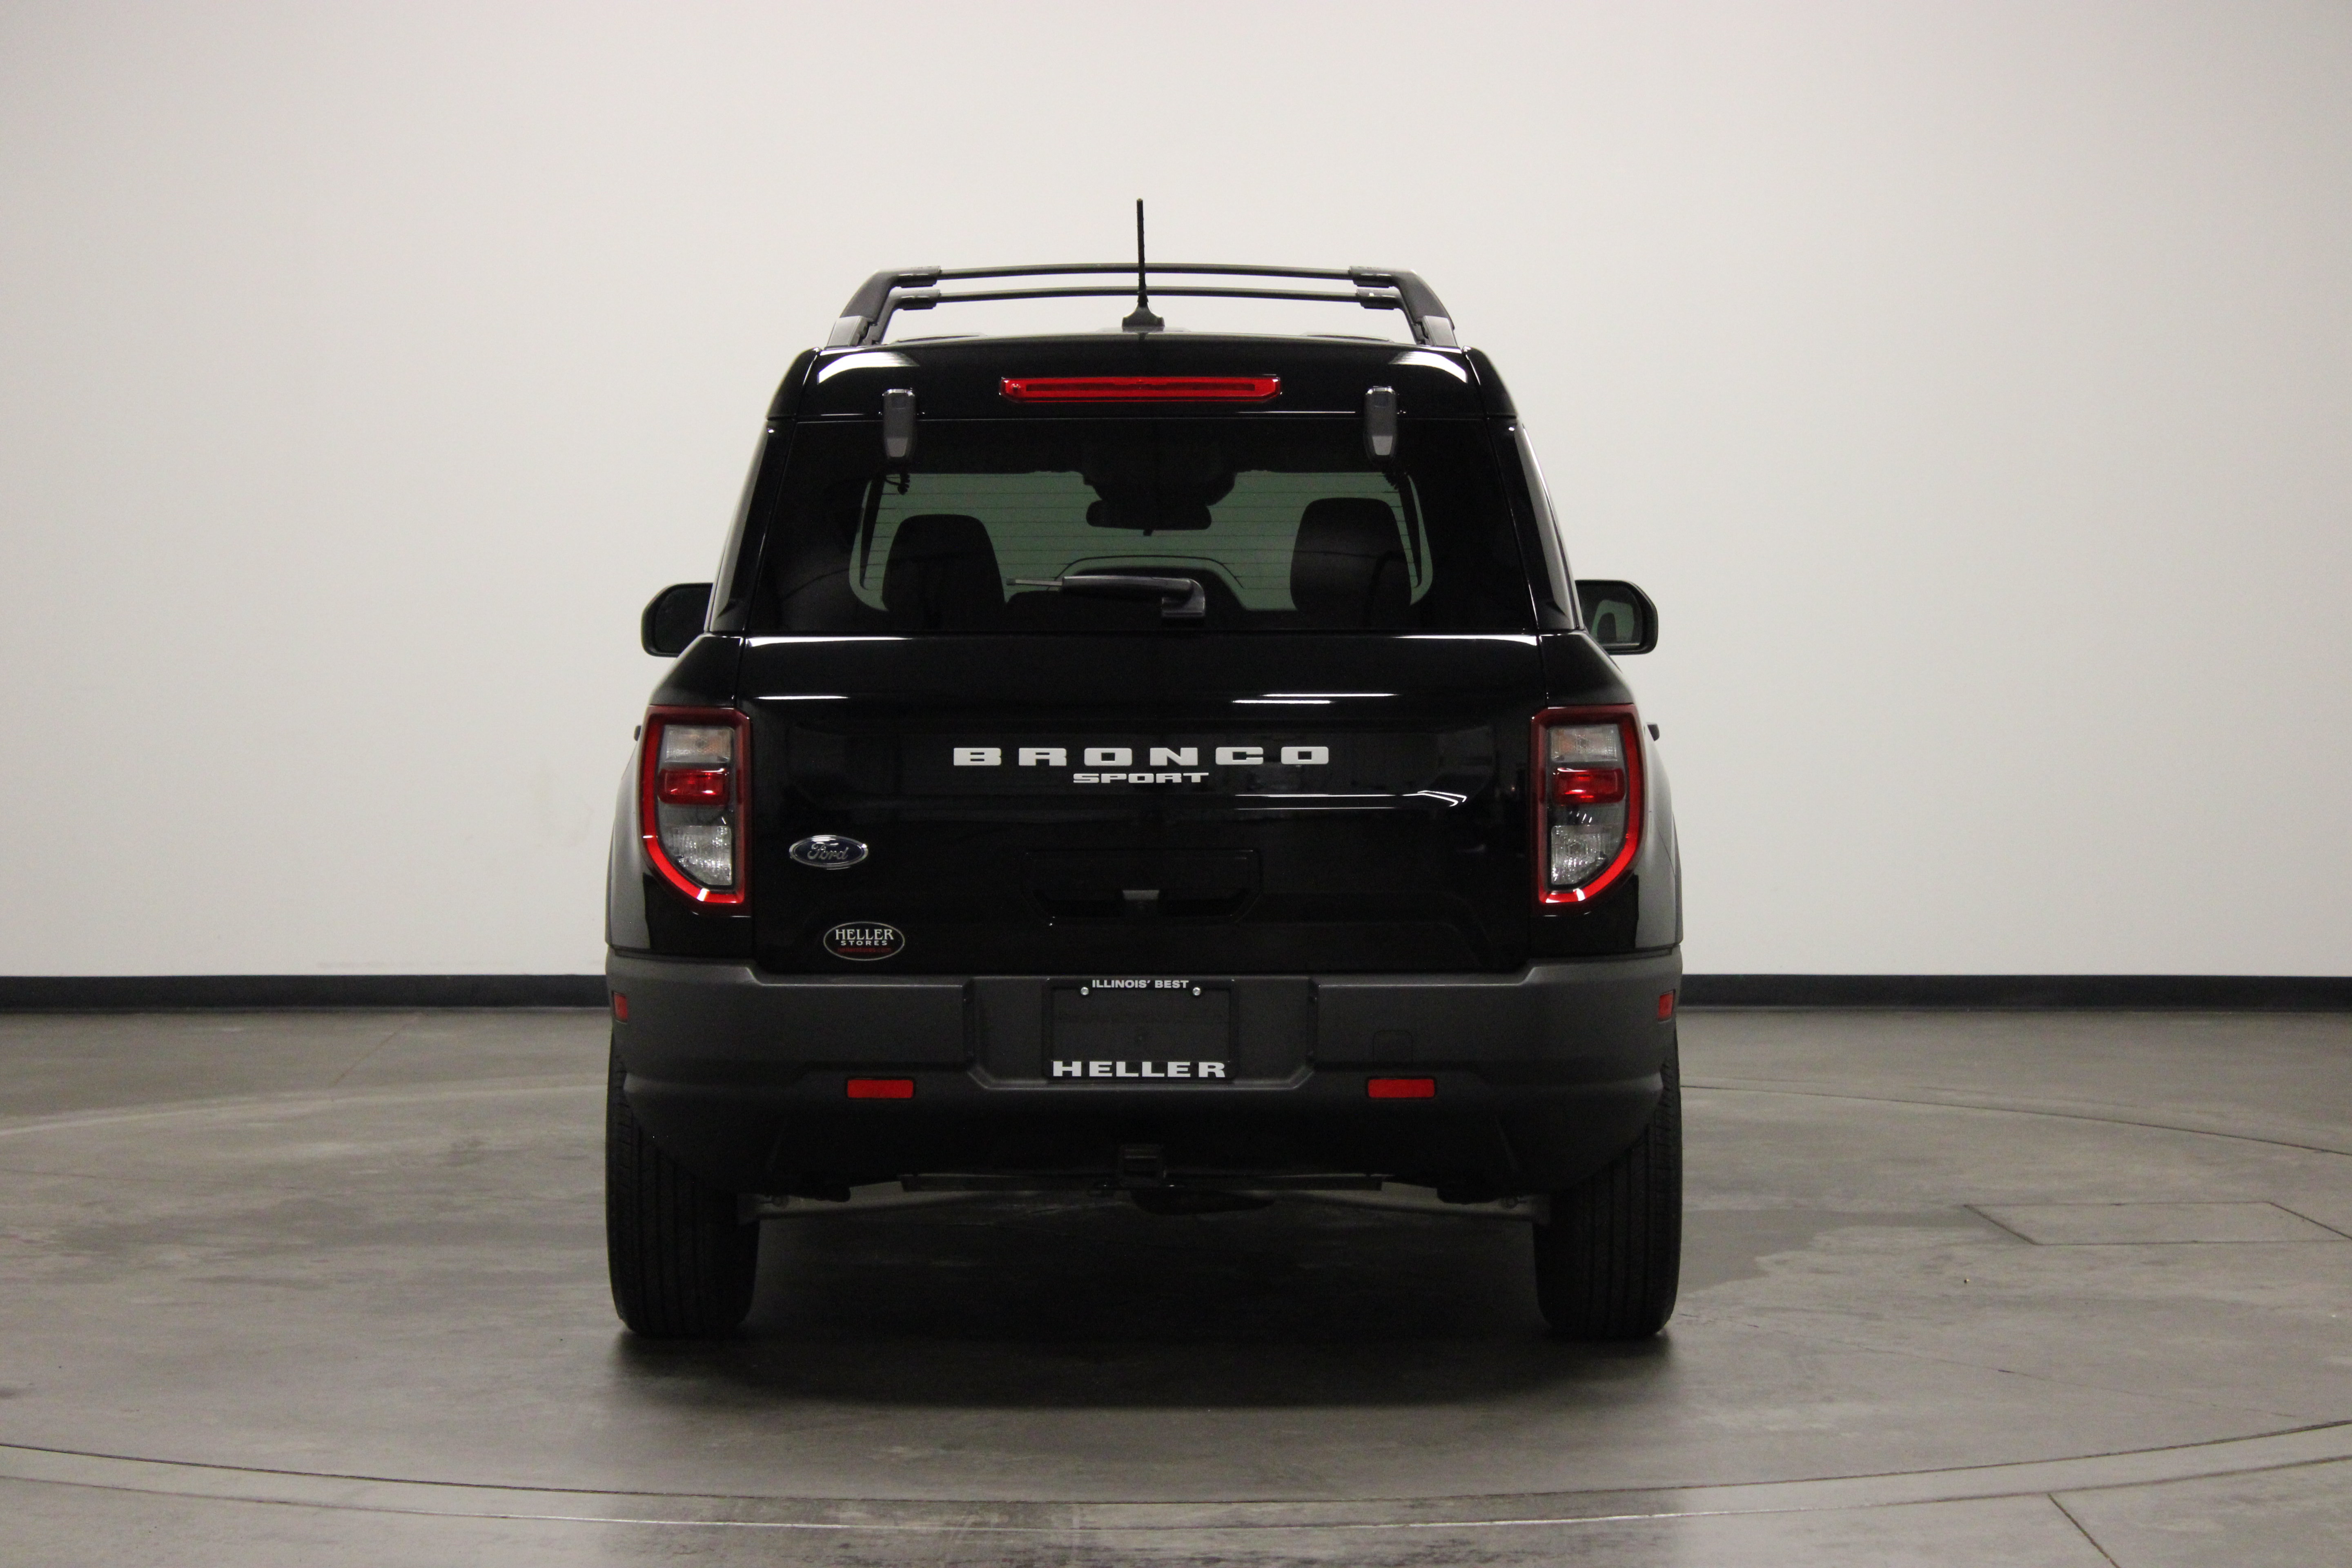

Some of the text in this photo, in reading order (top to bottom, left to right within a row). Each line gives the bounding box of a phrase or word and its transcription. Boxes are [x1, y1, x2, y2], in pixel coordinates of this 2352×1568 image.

[954, 746, 1329, 766] BRONCO
[1073, 772, 1209, 783] SPORT
[807, 842, 849, 859] Ford
[835, 929, 894, 940] HELLER
[1092, 980, 1189, 988] ILLINOIS' BEST
[1053, 1061, 1225, 1078] HELLER
